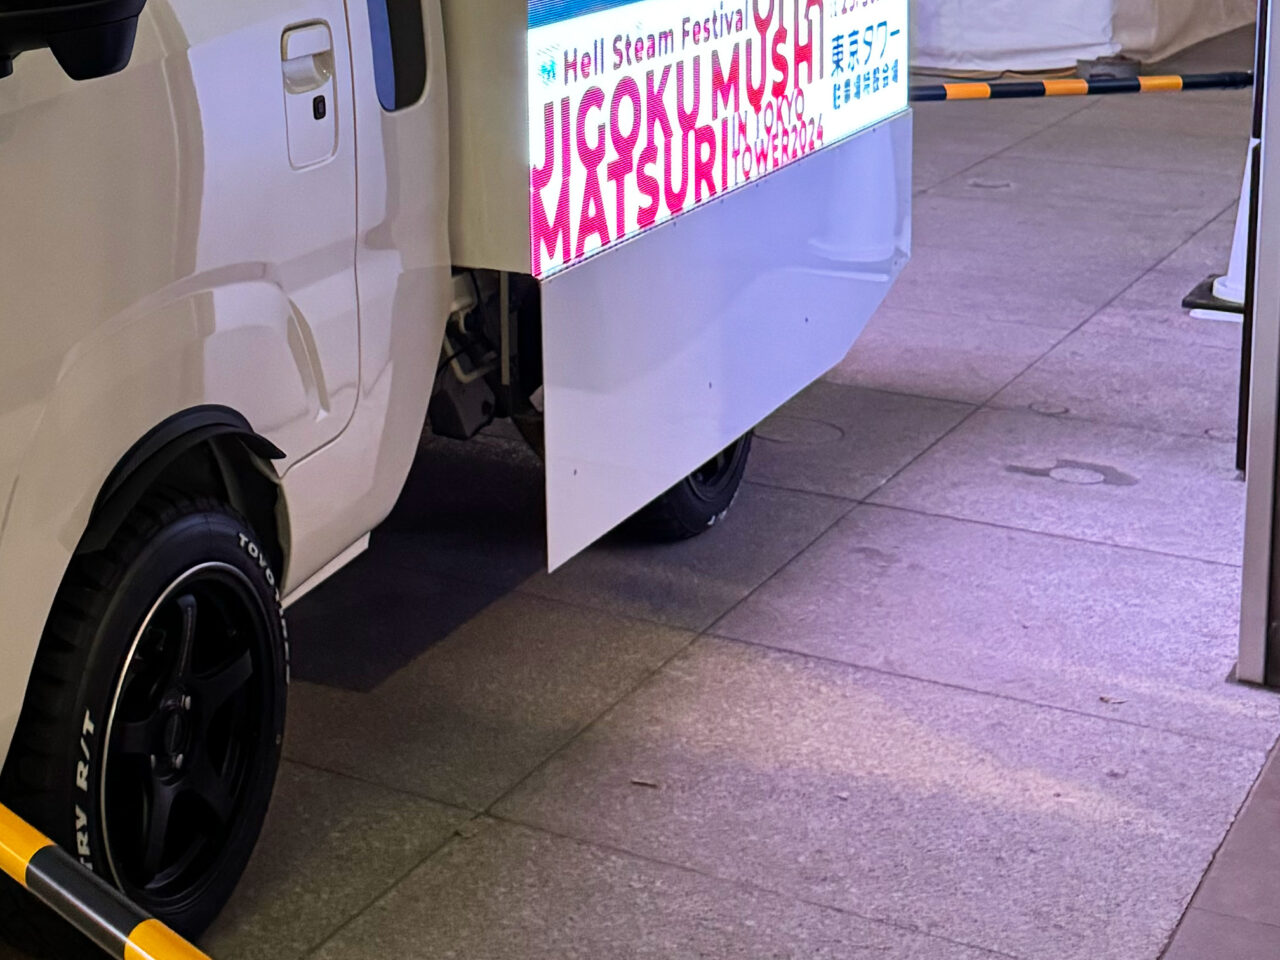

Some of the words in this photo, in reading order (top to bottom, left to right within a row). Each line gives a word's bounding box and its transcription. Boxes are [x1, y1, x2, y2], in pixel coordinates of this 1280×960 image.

[564, 38, 604, 86] Hell
[613, 28, 674, 71] Steam
[831, 20, 900, 77] 東京タワー
[531, 54, 701, 192] JIGOKU
[712, 16, 824, 122] MUSHI
[532, 117, 729, 277] MATSURI
[238, 531, 276, 587] TOYO
[75, 707, 97, 793] R/T
